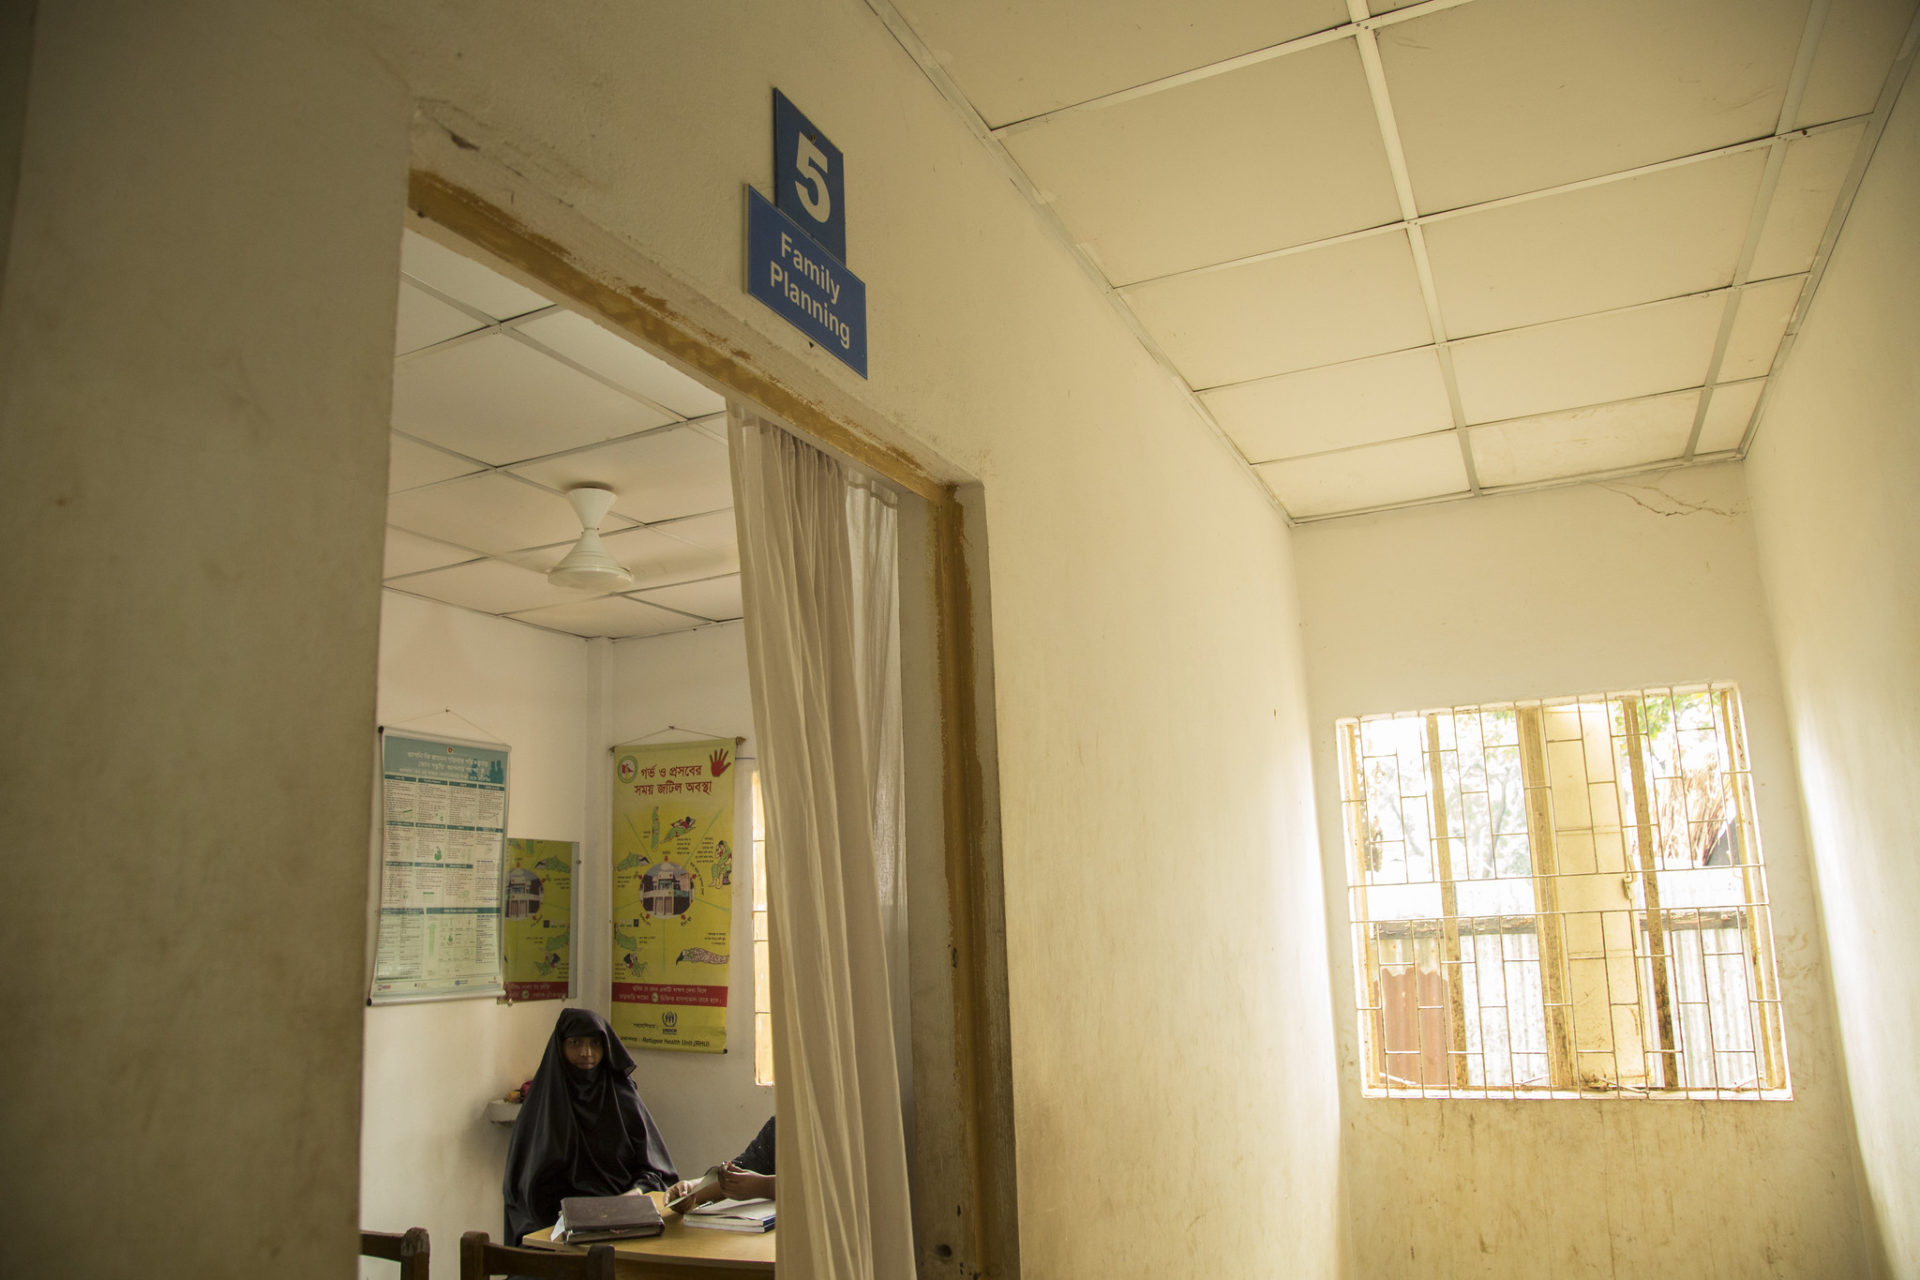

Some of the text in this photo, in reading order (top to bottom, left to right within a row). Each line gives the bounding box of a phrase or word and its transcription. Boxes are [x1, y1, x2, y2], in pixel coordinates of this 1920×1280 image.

[795, 131, 831, 223] 5
[781, 231, 840, 304] Family
[770, 260, 850, 350] Planning
[634, 780, 712, 795] সময় জটিল অবস্থা
[641, 764, 702, 779] গর্ভ ও প্রসবের
